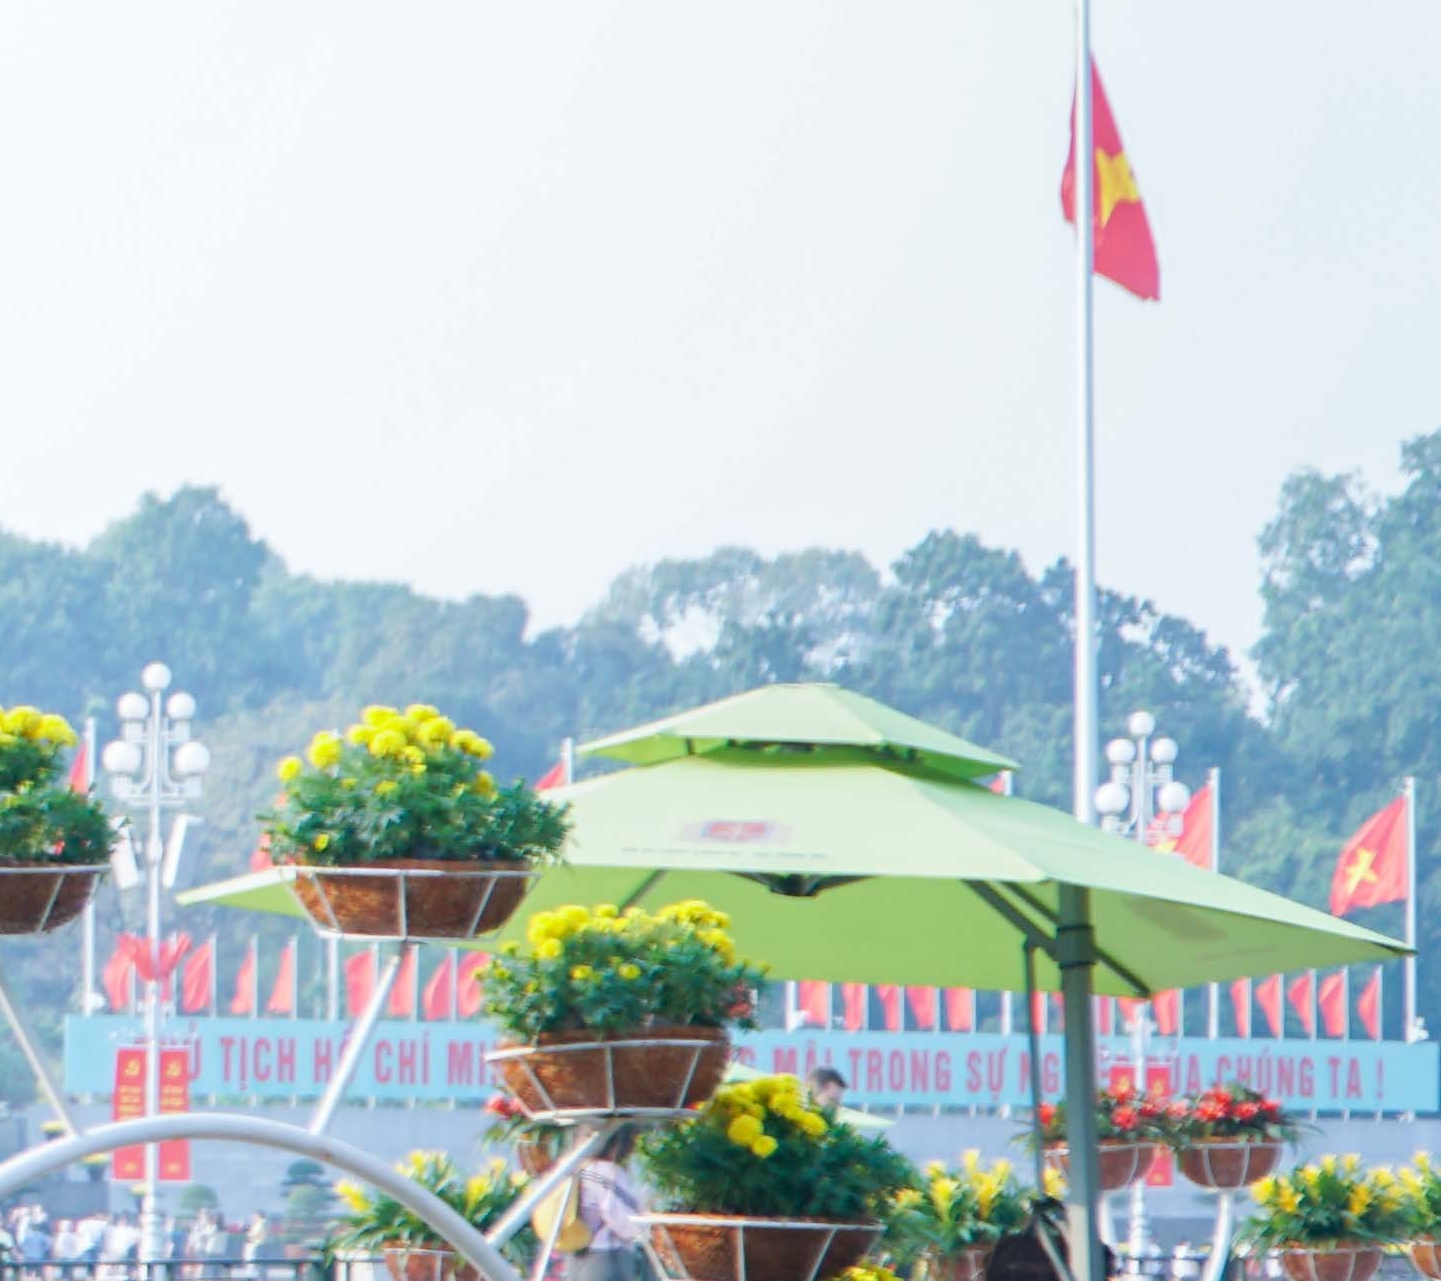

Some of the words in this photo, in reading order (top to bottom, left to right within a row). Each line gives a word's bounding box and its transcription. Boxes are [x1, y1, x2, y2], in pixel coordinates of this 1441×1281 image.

[219, 1037, 297, 1091] TỊCH
[374, 1030, 430, 1085] CHÍ
[847, 1048, 953, 1094] TRONG
[1214, 1046, 1315, 1098] CHÚNG
[1328, 1057, 1364, 1100] TA
